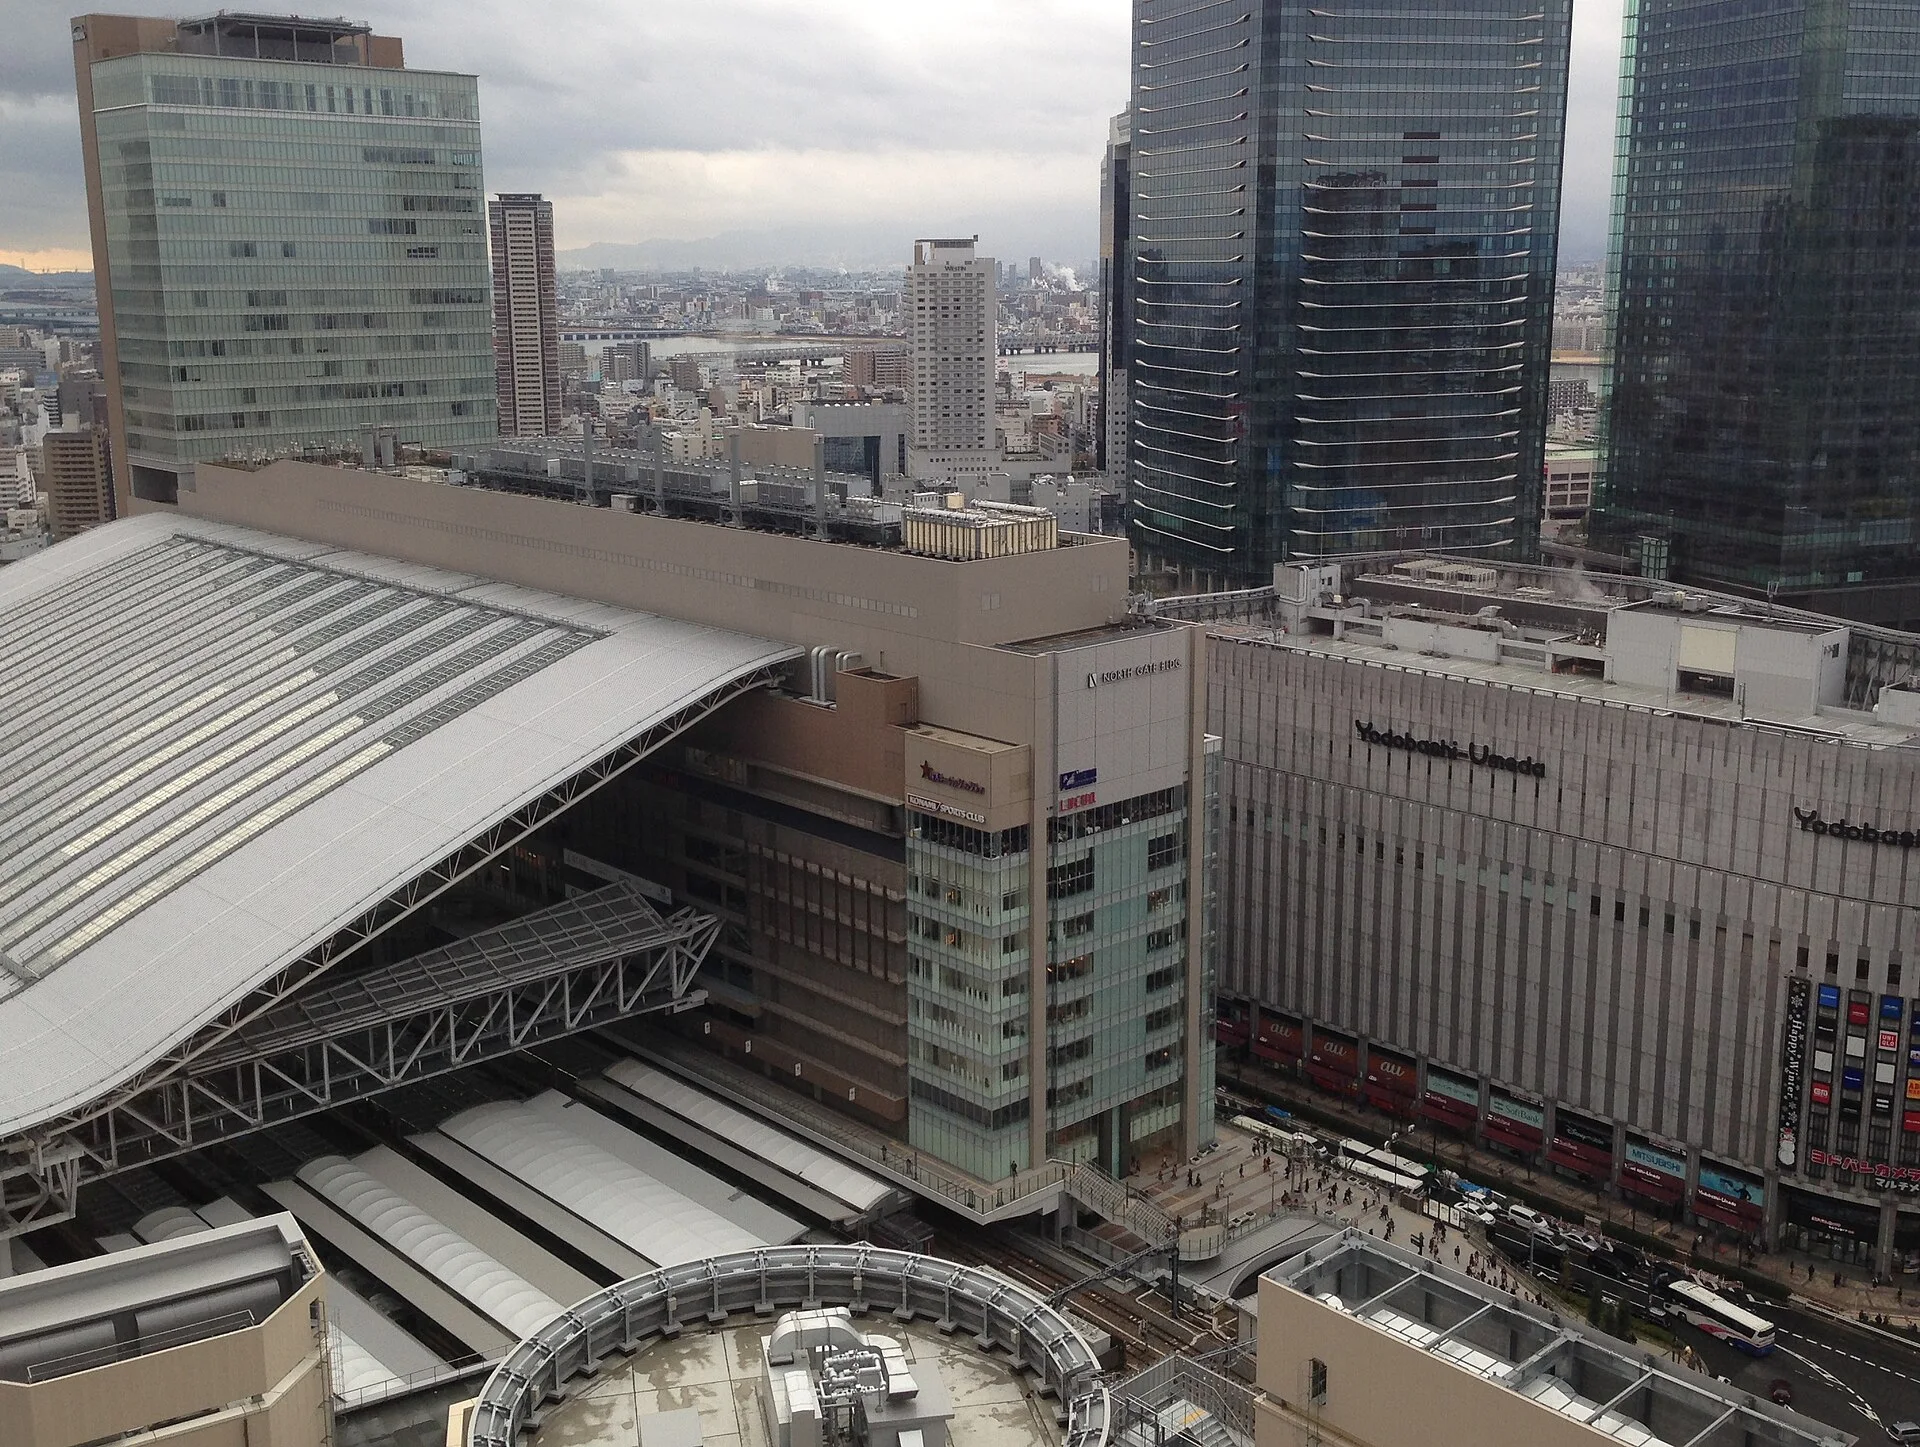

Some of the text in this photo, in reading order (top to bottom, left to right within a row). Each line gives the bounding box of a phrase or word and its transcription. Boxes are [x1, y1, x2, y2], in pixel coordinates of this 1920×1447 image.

[1102, 667, 1132, 683] NORTH
[1135, 662, 1158, 677] GATE
[1355, 719, 1546, 778] Yodobashi-Umeda
[909, 795, 985, 824] KONAMI SPORTS CLUB
[1270, 1023, 1292, 1038] au
[1323, 1041, 1348, 1057] au
[1786, 1018, 1803, 1099] Happy Winter
[1380, 1061, 1405, 1077] au
[1505, 1104, 1540, 1124] SoftBank
[1631, 1148, 1681, 1172] MITSUBISHI
